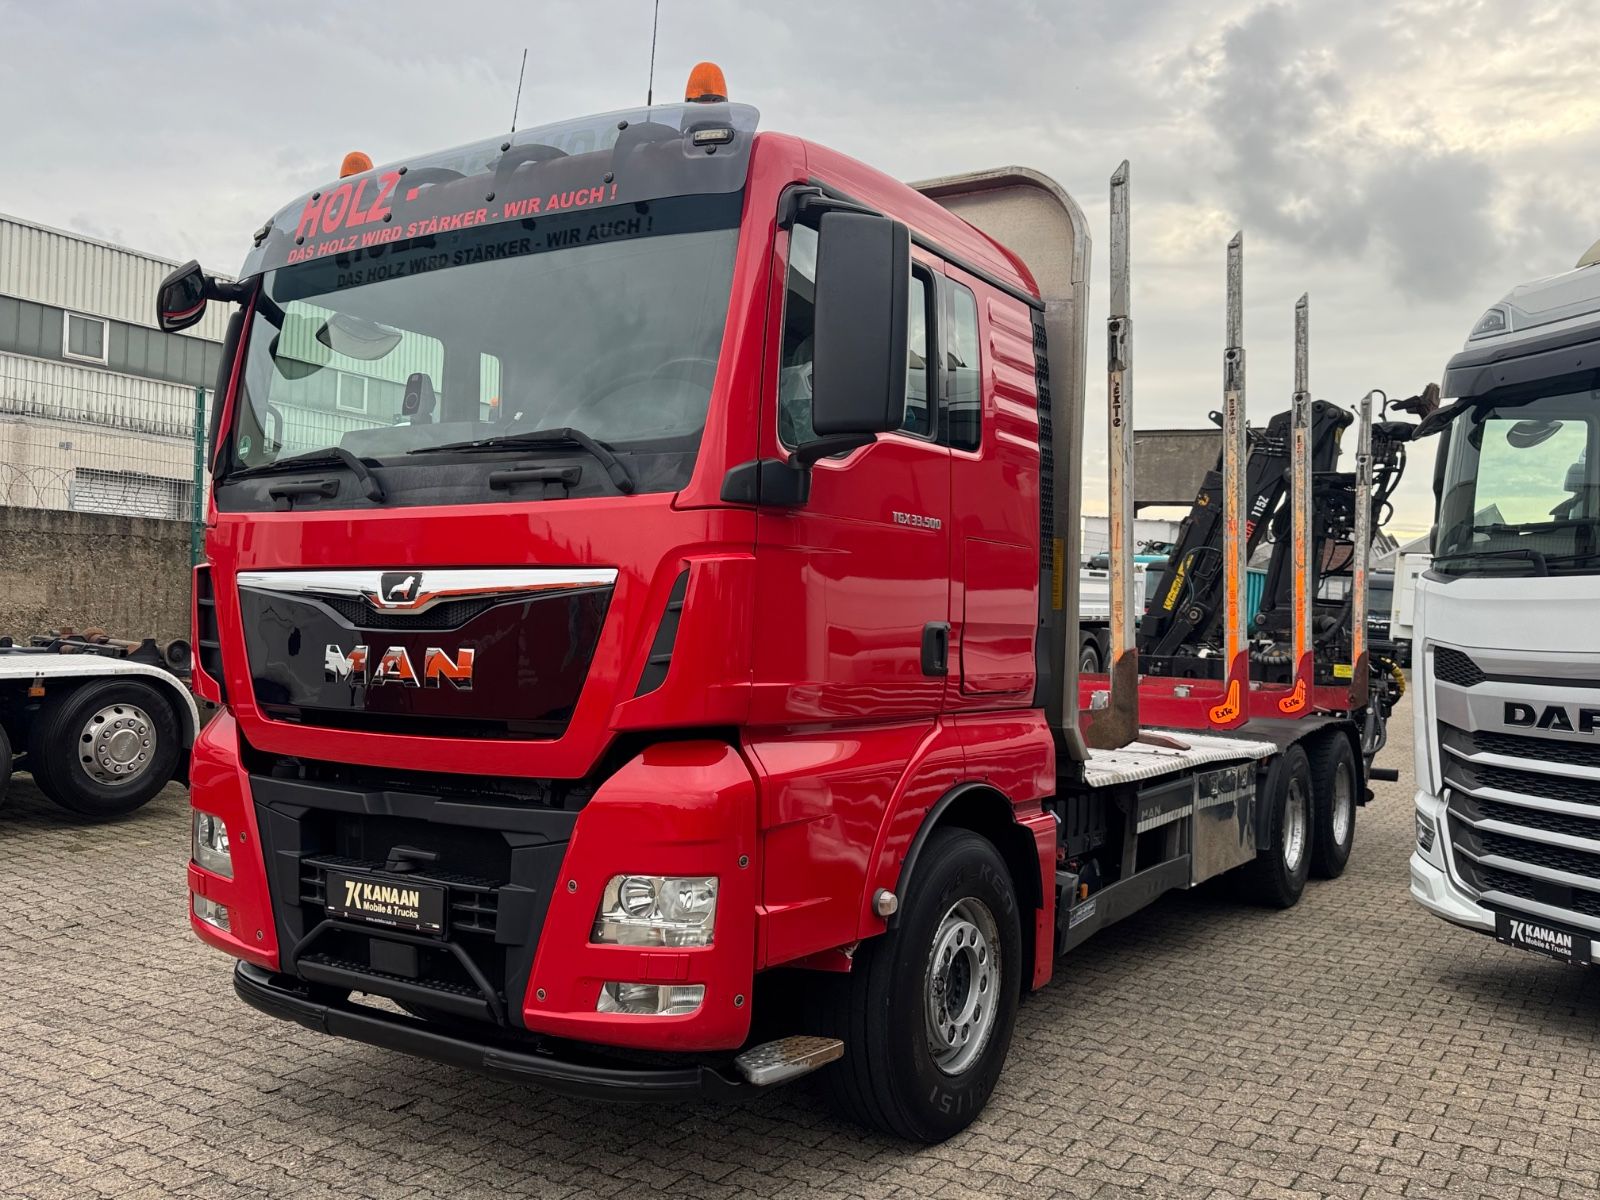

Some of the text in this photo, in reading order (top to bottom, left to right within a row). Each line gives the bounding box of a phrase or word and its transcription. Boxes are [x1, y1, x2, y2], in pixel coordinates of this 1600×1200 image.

[294, 171, 401, 241] HOLZ
[287, 245, 315, 264] DAS
[317, 235, 359, 256] HOLZ
[361, 226, 403, 246] WIRD
[406, 208, 488, 238] STÄRKER
[503, 197, 542, 219] WIR
[546, 185, 605, 211] AUCH
[1250, 495, 1270, 517] 115Z
[892, 511, 942, 530] TGX 33.500
[324, 644, 475, 690] MAN
[1503, 701, 1600, 735] DAF
[363, 883, 420, 908] KANAAN
[363, 901, 419, 919] Mobile & Trucks
[1525, 924, 1572, 948] KANAAN
[1525, 936, 1545, 949] Mobile
[1545, 942, 1551, 950] &
[1550, 943, 1572, 956] Trucks
